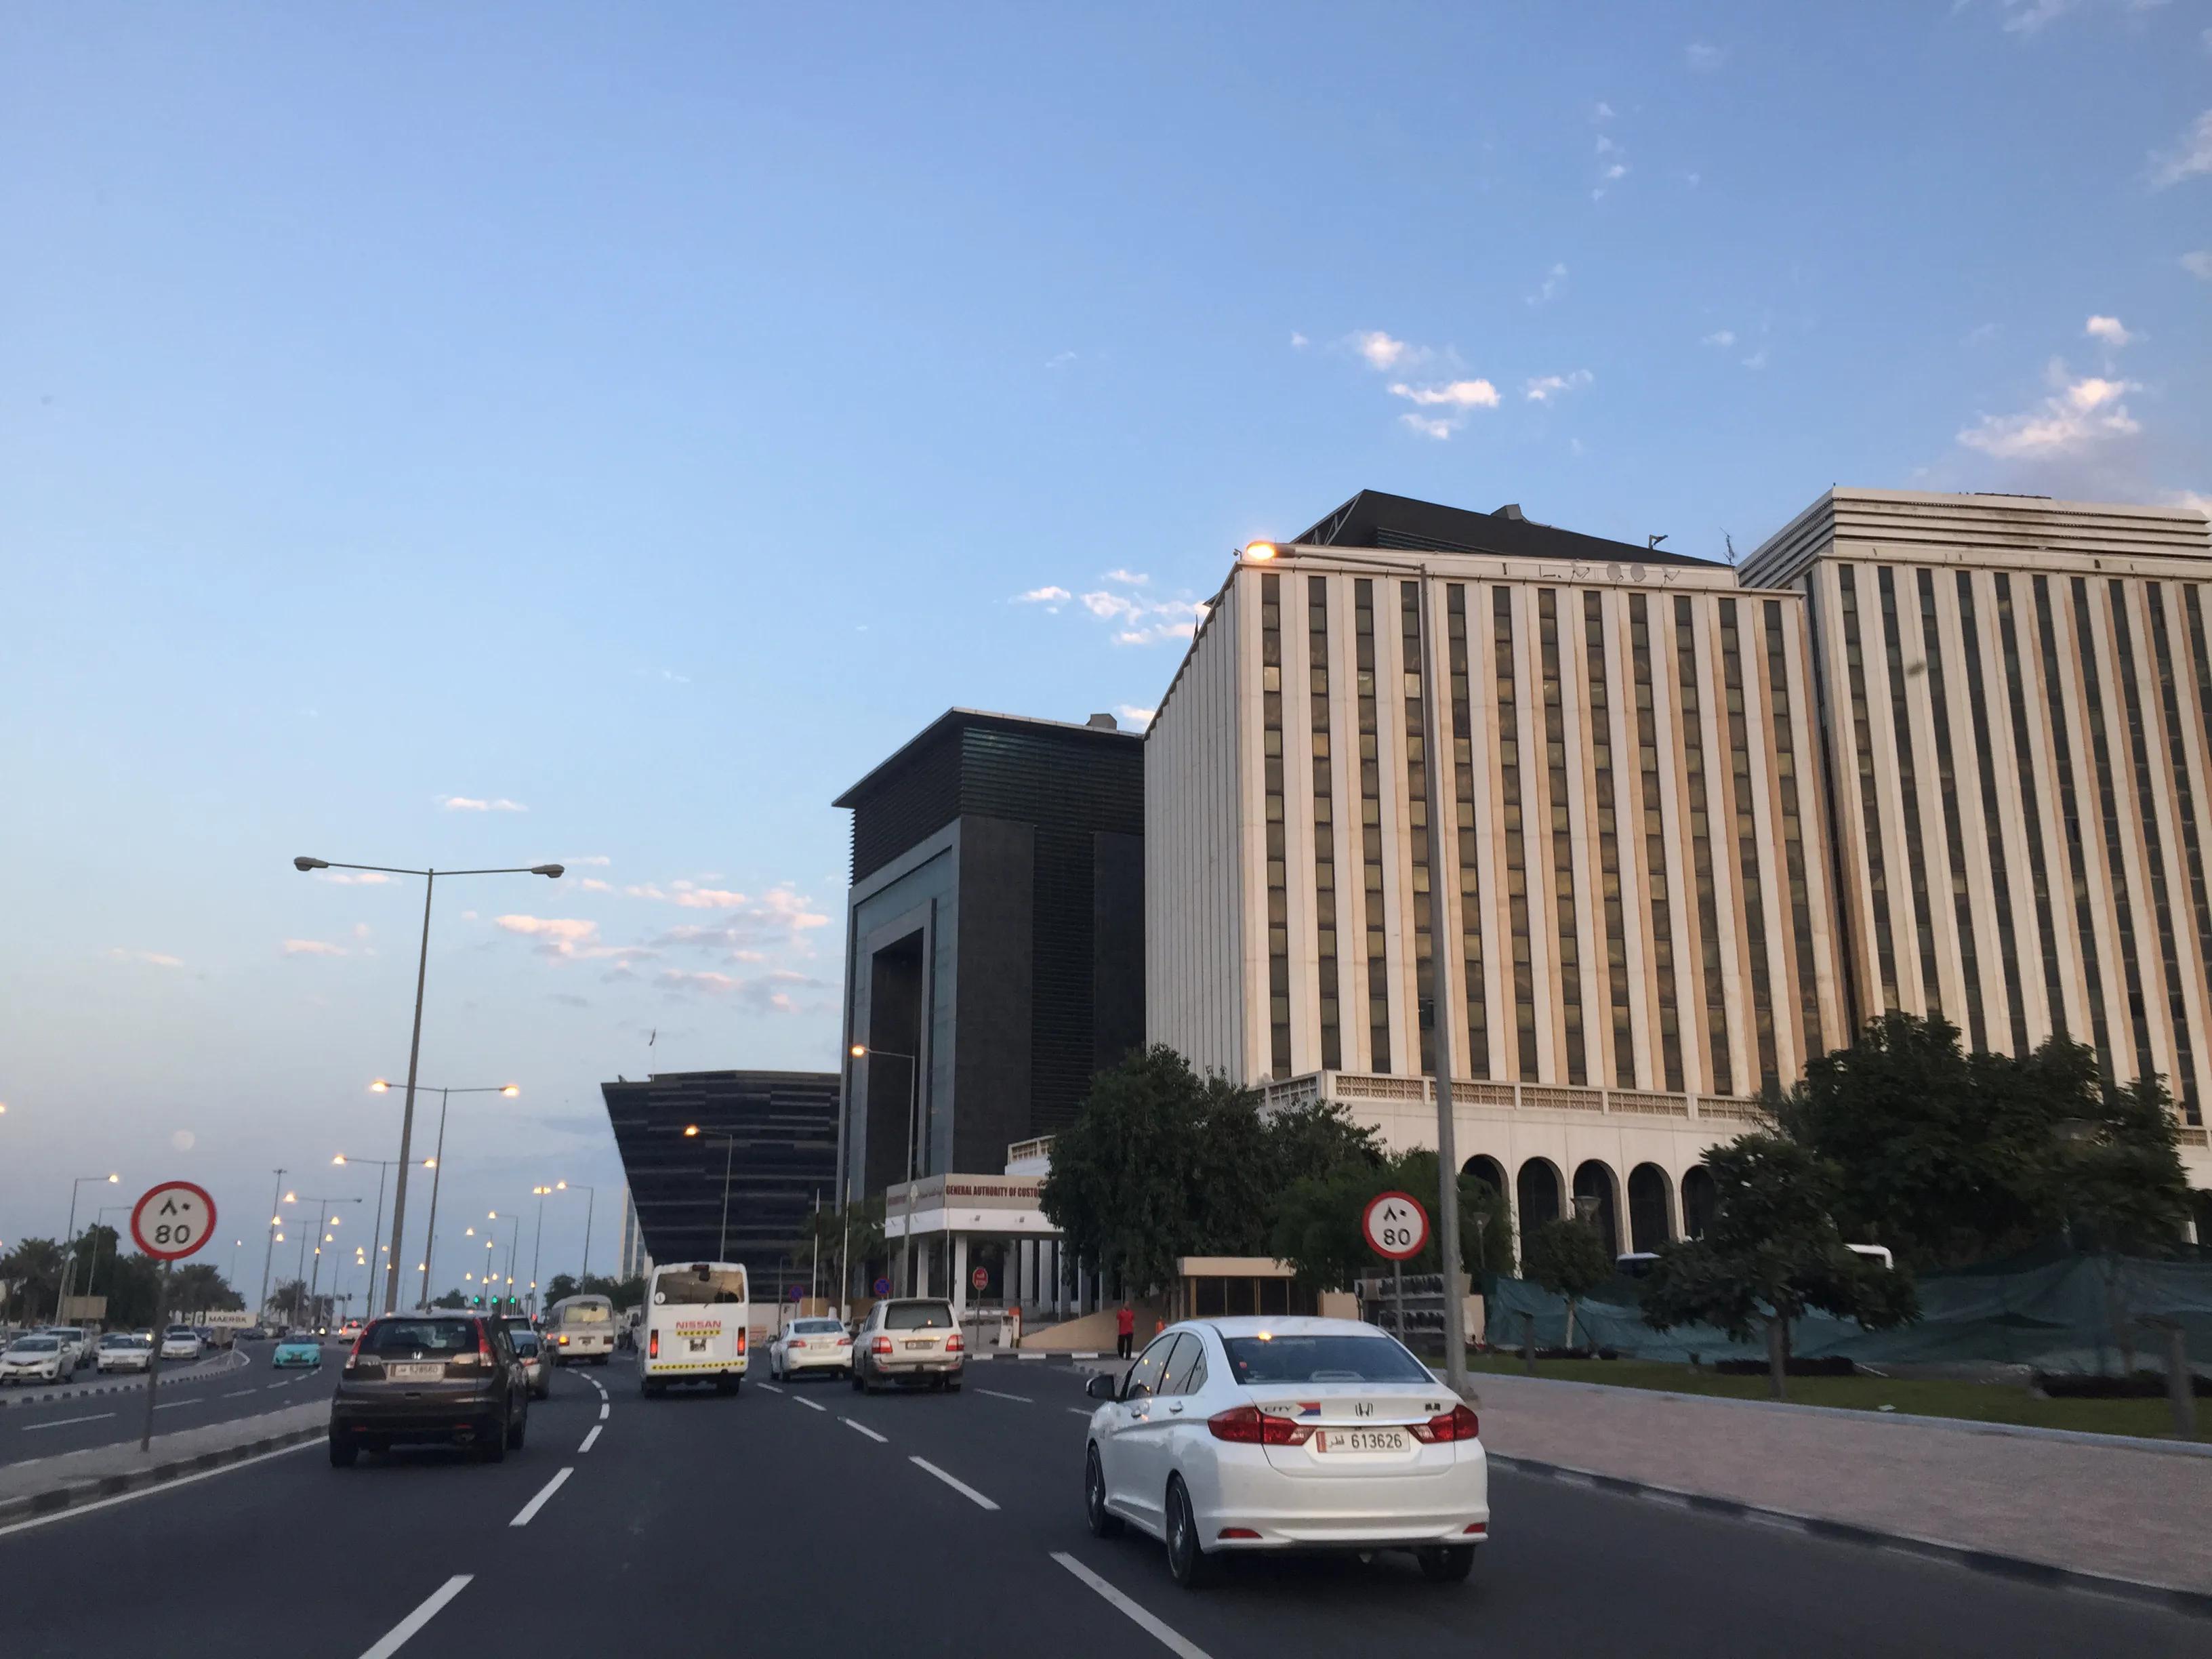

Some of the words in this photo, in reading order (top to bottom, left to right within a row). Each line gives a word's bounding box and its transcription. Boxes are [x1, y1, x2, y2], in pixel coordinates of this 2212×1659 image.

[946, 1185, 972, 1196] GENERAL
[973, 1186, 1008, 1197] AUTHORITY
[1009, 1187, 1017, 1197] OF
[155, 1225, 190, 1244] 80
[1384, 1229, 1410, 1246] 80
[676, 1320, 721, 1329] NISSAN
[1351, 1433, 1403, 1449] 613626
